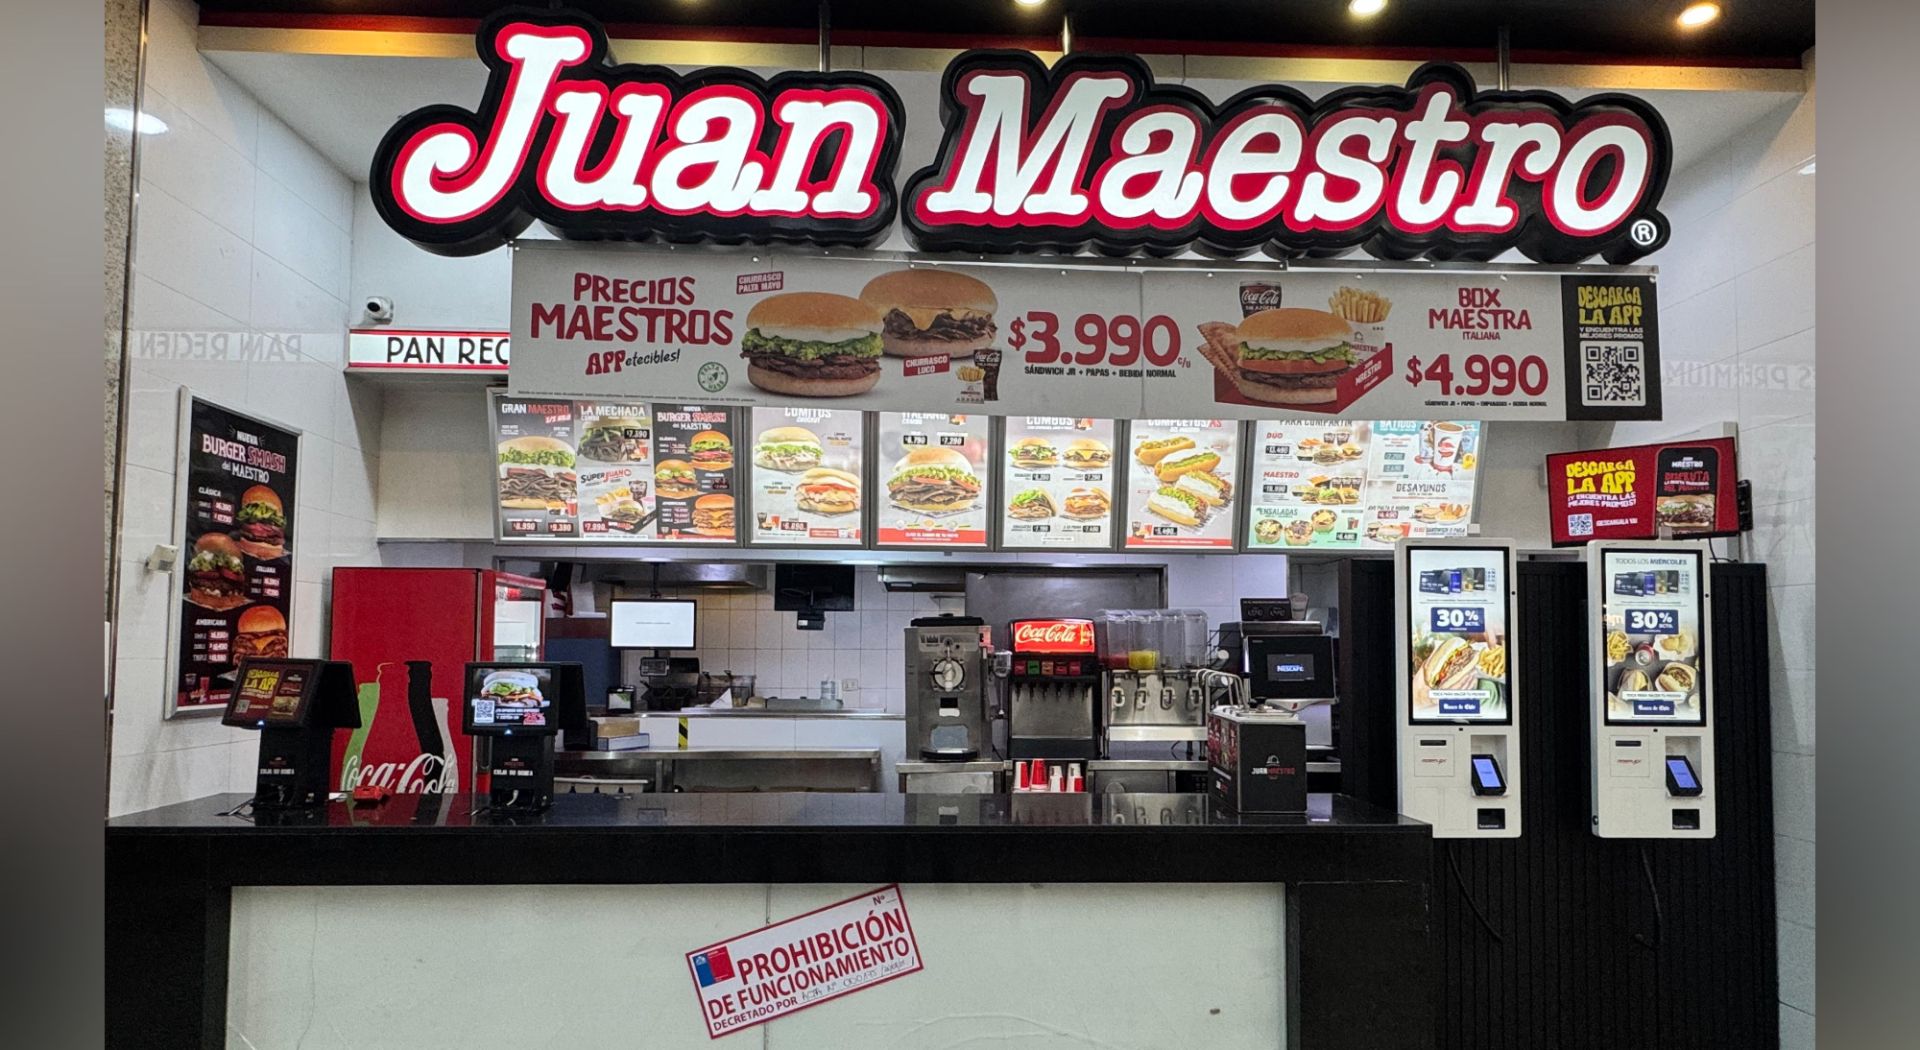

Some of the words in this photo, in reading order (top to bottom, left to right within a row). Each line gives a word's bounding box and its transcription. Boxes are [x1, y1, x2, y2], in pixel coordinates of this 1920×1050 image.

[400, 32, 874, 220] Juan
[926, 73, 1651, 231] Maestro
[573, 272, 696, 306] PRECIOS
[1458, 287, 1502, 308] BOX
[1577, 285, 1643, 309] DESCARGA
[530, 302, 734, 346] MAESTROS
[1428, 308, 1533, 331] MAESTRA
[1578, 308, 1606, 325] LA
[1608, 304, 1643, 325] APP
[1007, 310, 1182, 367] $3.990
[1462, 331, 1501, 341] ITALIANA
[387, 337, 444, 364] PAN
[905, 355, 948, 368] CHURRASCO
[917, 365, 936, 375] LUCO
[1024, 365, 1064, 375] SÁNDWICH
[1066, 368, 1076, 376] JR
[1085, 368, 1110, 377] PAPAS
[1146, 369, 1177, 378] NORMAL
[1405, 353, 1549, 397] $4.990
[501, 403, 527, 414] GRAN
[528, 404, 570, 415] MAESTRO
[580, 405, 594, 416] LA
[595, 405, 646, 417] MECHADA
[656, 412, 691, 422] BURGER
[202, 433, 247, 463] BURGER
[247, 445, 286, 474] SMASH
[231, 462, 270, 484] MAESTRO
[1565, 459, 1636, 478] DESCARGA
[1396, 483, 1447, 493] DESAYUNOS
[1567, 477, 1597, 495] LA
[1600, 470, 1636, 494] APP
[1015, 622, 1078, 644] Coca-Cola
[736, 907, 905, 986] PROHIBICIÓN
[707, 994, 736, 1020] DE
[737, 936, 910, 1010] FUNCIONAMIENTO
[712, 1004, 775, 1032] DECRETADO
[775, 997, 799, 1012] POR
